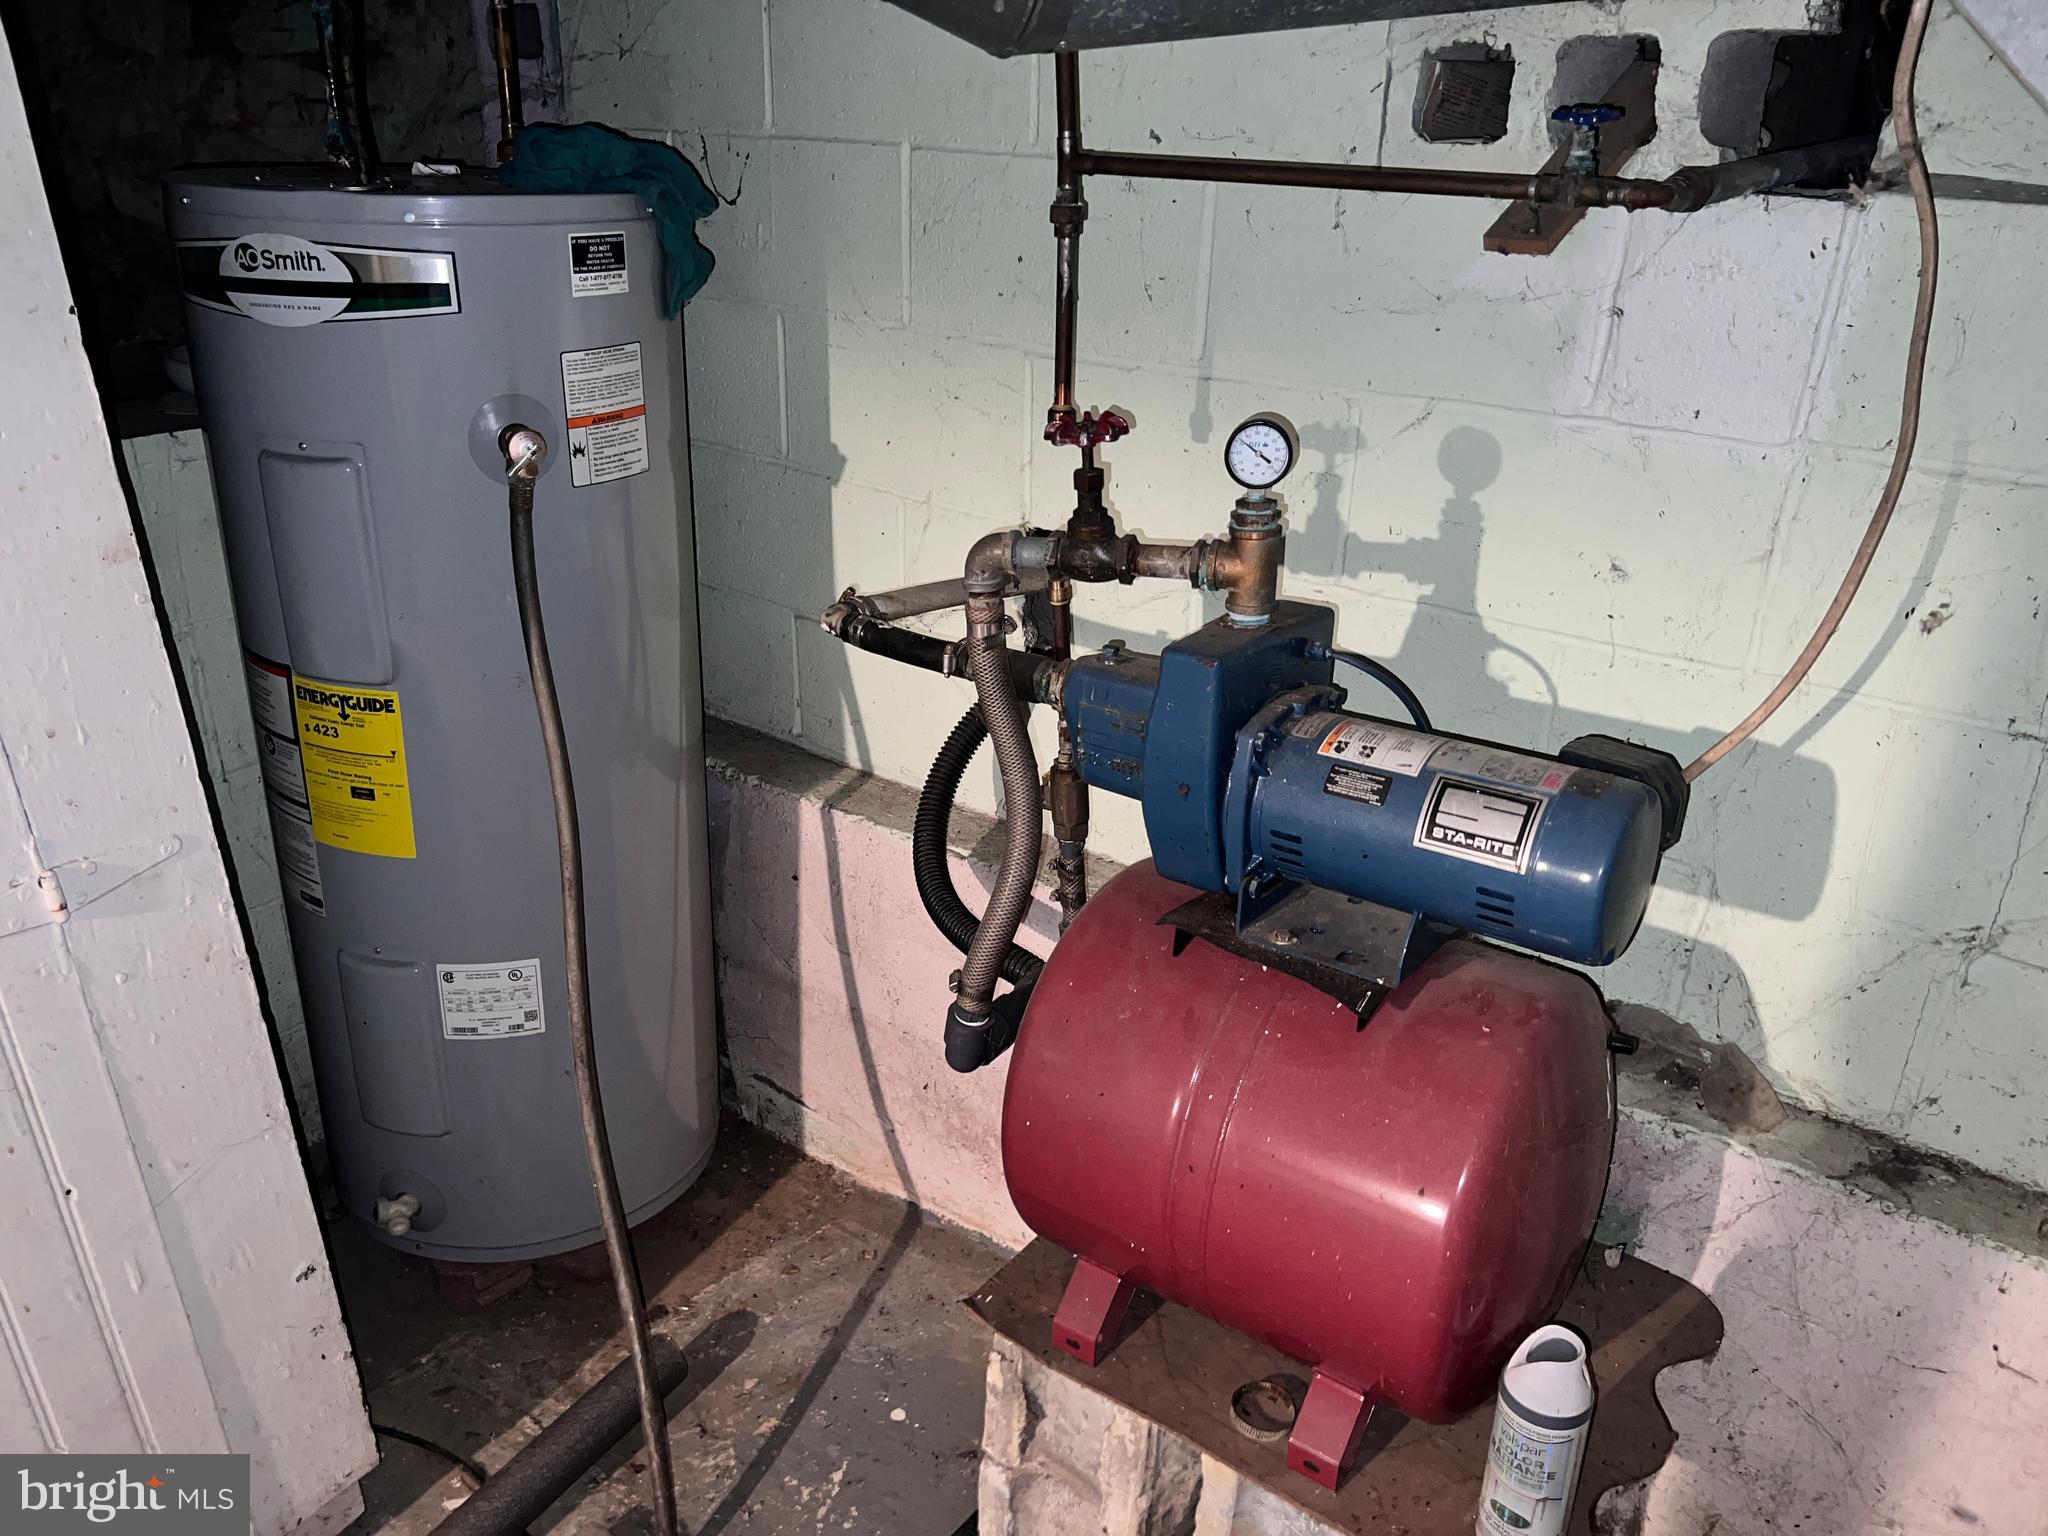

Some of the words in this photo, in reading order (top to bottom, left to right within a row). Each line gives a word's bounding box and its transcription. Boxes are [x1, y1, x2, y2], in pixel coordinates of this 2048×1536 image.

[296, 684, 396, 714] ENERGYGUIDE
[304, 723, 310, 732] $
[313, 723, 339, 738] 423
[1432, 827, 1515, 857] STA-RITE
[1499, 1439, 1544, 1470] COLOR
[1501, 1426, 1547, 1456] valspar
[1492, 1434, 1557, 1480] RADIANCE
